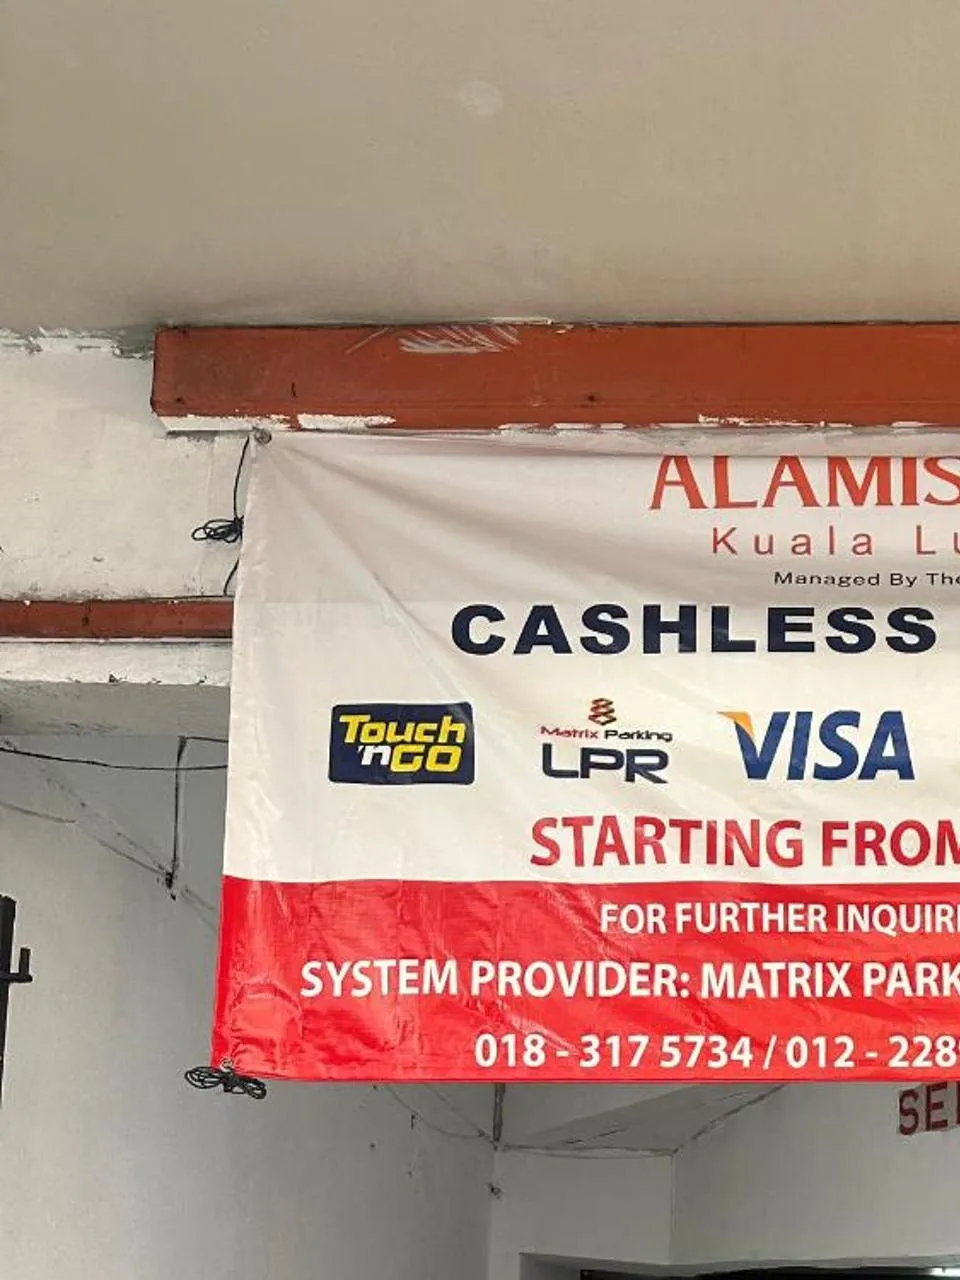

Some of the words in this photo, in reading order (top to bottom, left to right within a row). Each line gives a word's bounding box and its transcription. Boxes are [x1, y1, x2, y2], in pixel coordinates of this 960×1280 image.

[711, 524, 874, 556] Kuala
[773, 570, 880, 588] Managed
[890, 572, 918, 588] By
[451, 603, 937, 656] CASHLESS
[339, 714, 467, 744] Touch
[540, 726, 598, 740] Matrix
[604, 729, 673, 742] Parking
[717, 710, 915, 781] VISA
[542, 742, 670, 784] LPR
[530, 814, 803, 868] STARTING
[600, 902, 666, 934] FOR
[675, 902, 827, 934] FURTHER
[300, 958, 458, 998] SYSTEM
[471, 960, 691, 1000] PROVIDER:
[701, 962, 851, 1000] MATRIX
[474, 1033, 546, 1068] 018
[580, 1034, 650, 1069] 317
[660, 1034, 753, 1069] 5734
[785, 1034, 856, 1069] 012
